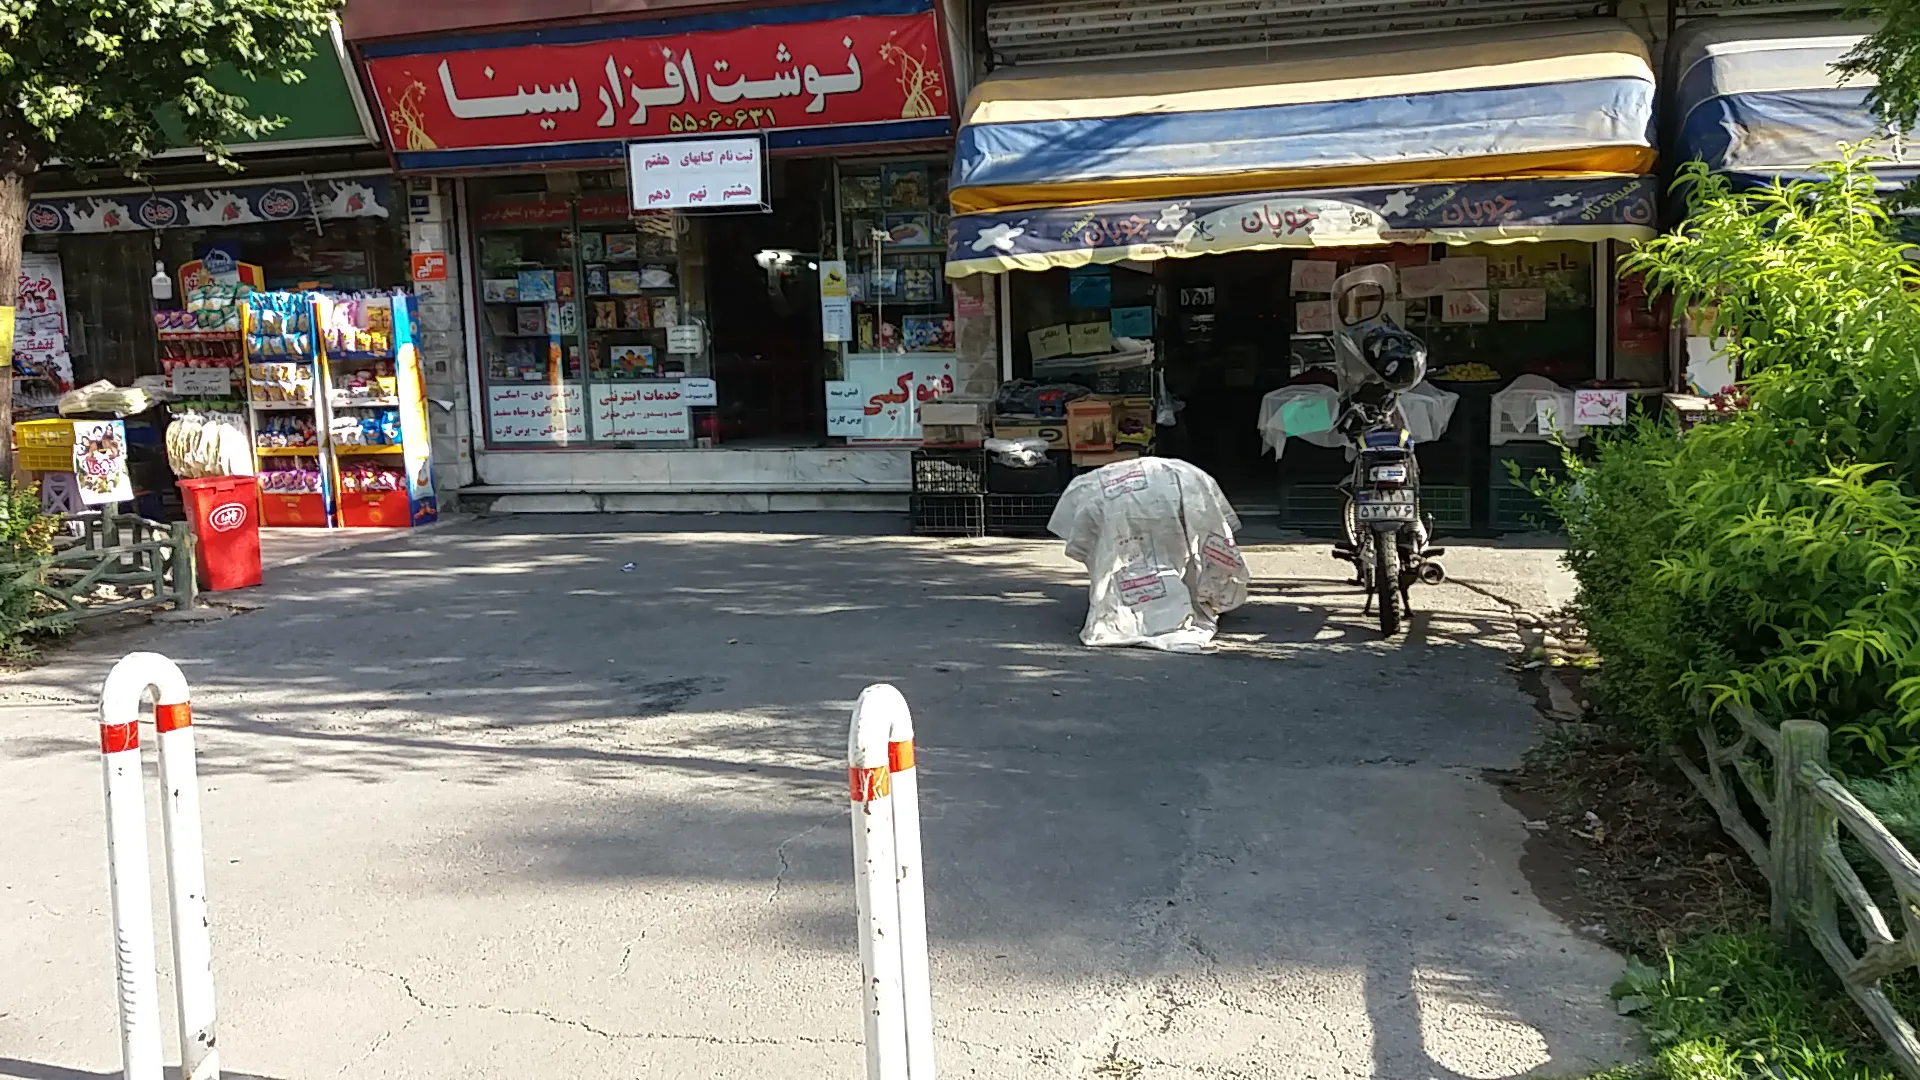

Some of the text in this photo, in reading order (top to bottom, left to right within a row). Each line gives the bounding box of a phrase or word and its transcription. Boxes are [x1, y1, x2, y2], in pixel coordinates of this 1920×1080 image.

[437, 35, 861, 131] نوشت افزار سینا
[669, 108, 776, 132] ۵۵۰۶۰۶۳۱
[645, 149, 753, 170] ثبت نام کتابهای هفتم
[648, 183, 751, 204] هشتم نهم دهم
[1085, 215, 1150, 248] چوپان
[1242, 204, 1320, 238] چوپان
[494, 389, 520, 402] اسکن
[599, 387, 681, 407] خدمات اینترنتی
[863, 362, 955, 421] فتوکپی
